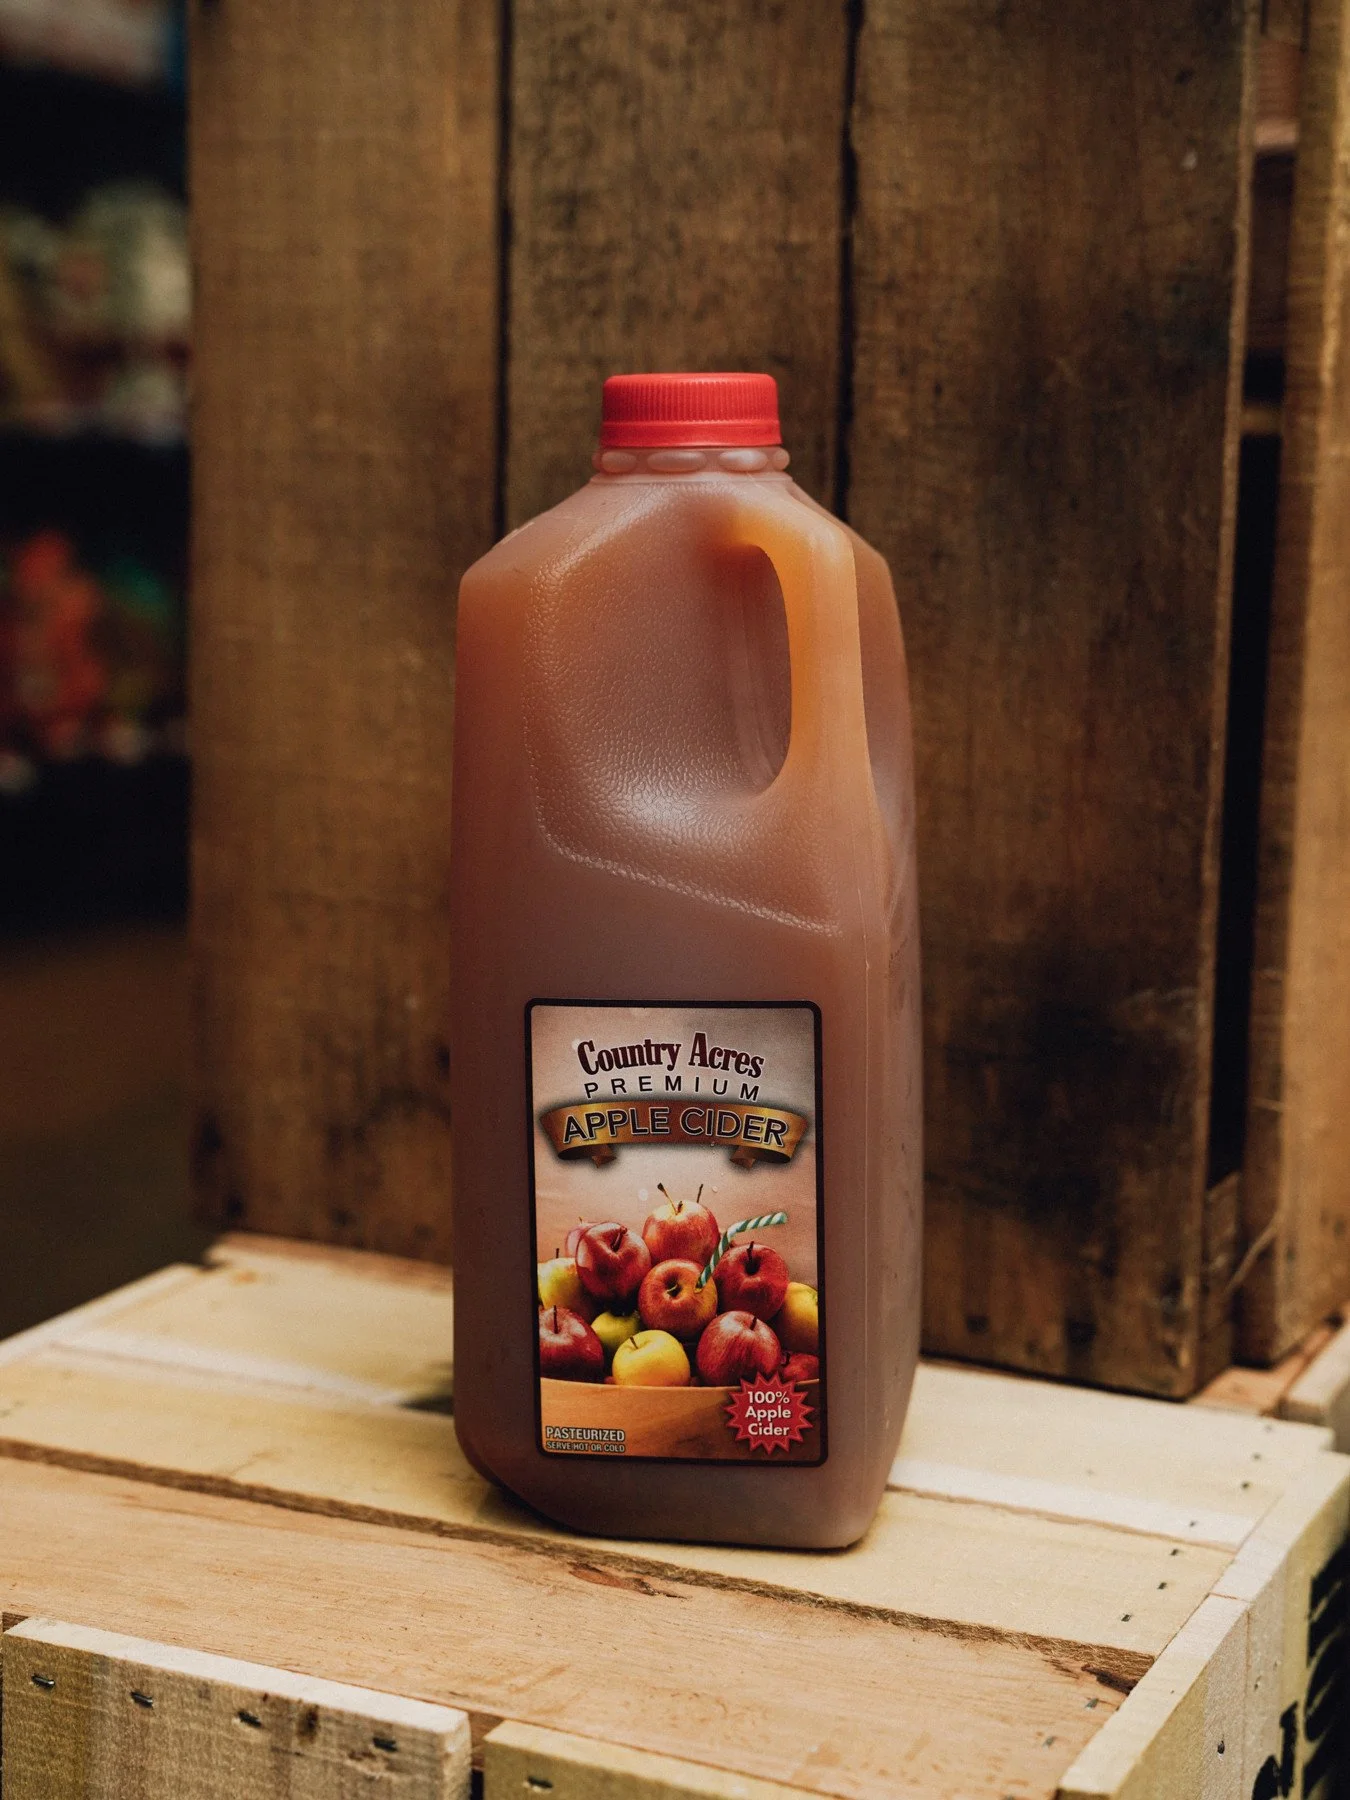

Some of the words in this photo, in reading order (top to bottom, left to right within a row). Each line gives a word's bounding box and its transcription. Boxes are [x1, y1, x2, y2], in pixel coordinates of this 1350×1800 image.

[577, 1038, 682, 1076] Country
[688, 1031, 765, 1079] Acres
[584, 1075, 760, 1102] PREMIUM
[563, 1107, 671, 1144] APPLE
[680, 1107, 788, 1146] CIDER
[747, 1391, 790, 1404] 100%
[745, 1404, 791, 1422] Apple
[546, 1426, 625, 1442] PASTEURIZED
[747, 1422, 790, 1436] Cider
[547, 1441, 571, 1450] SERVE
[573, 1443, 589, 1451] HOT
[590, 1443, 602, 1452] OR
[604, 1444, 625, 1453] COLD
